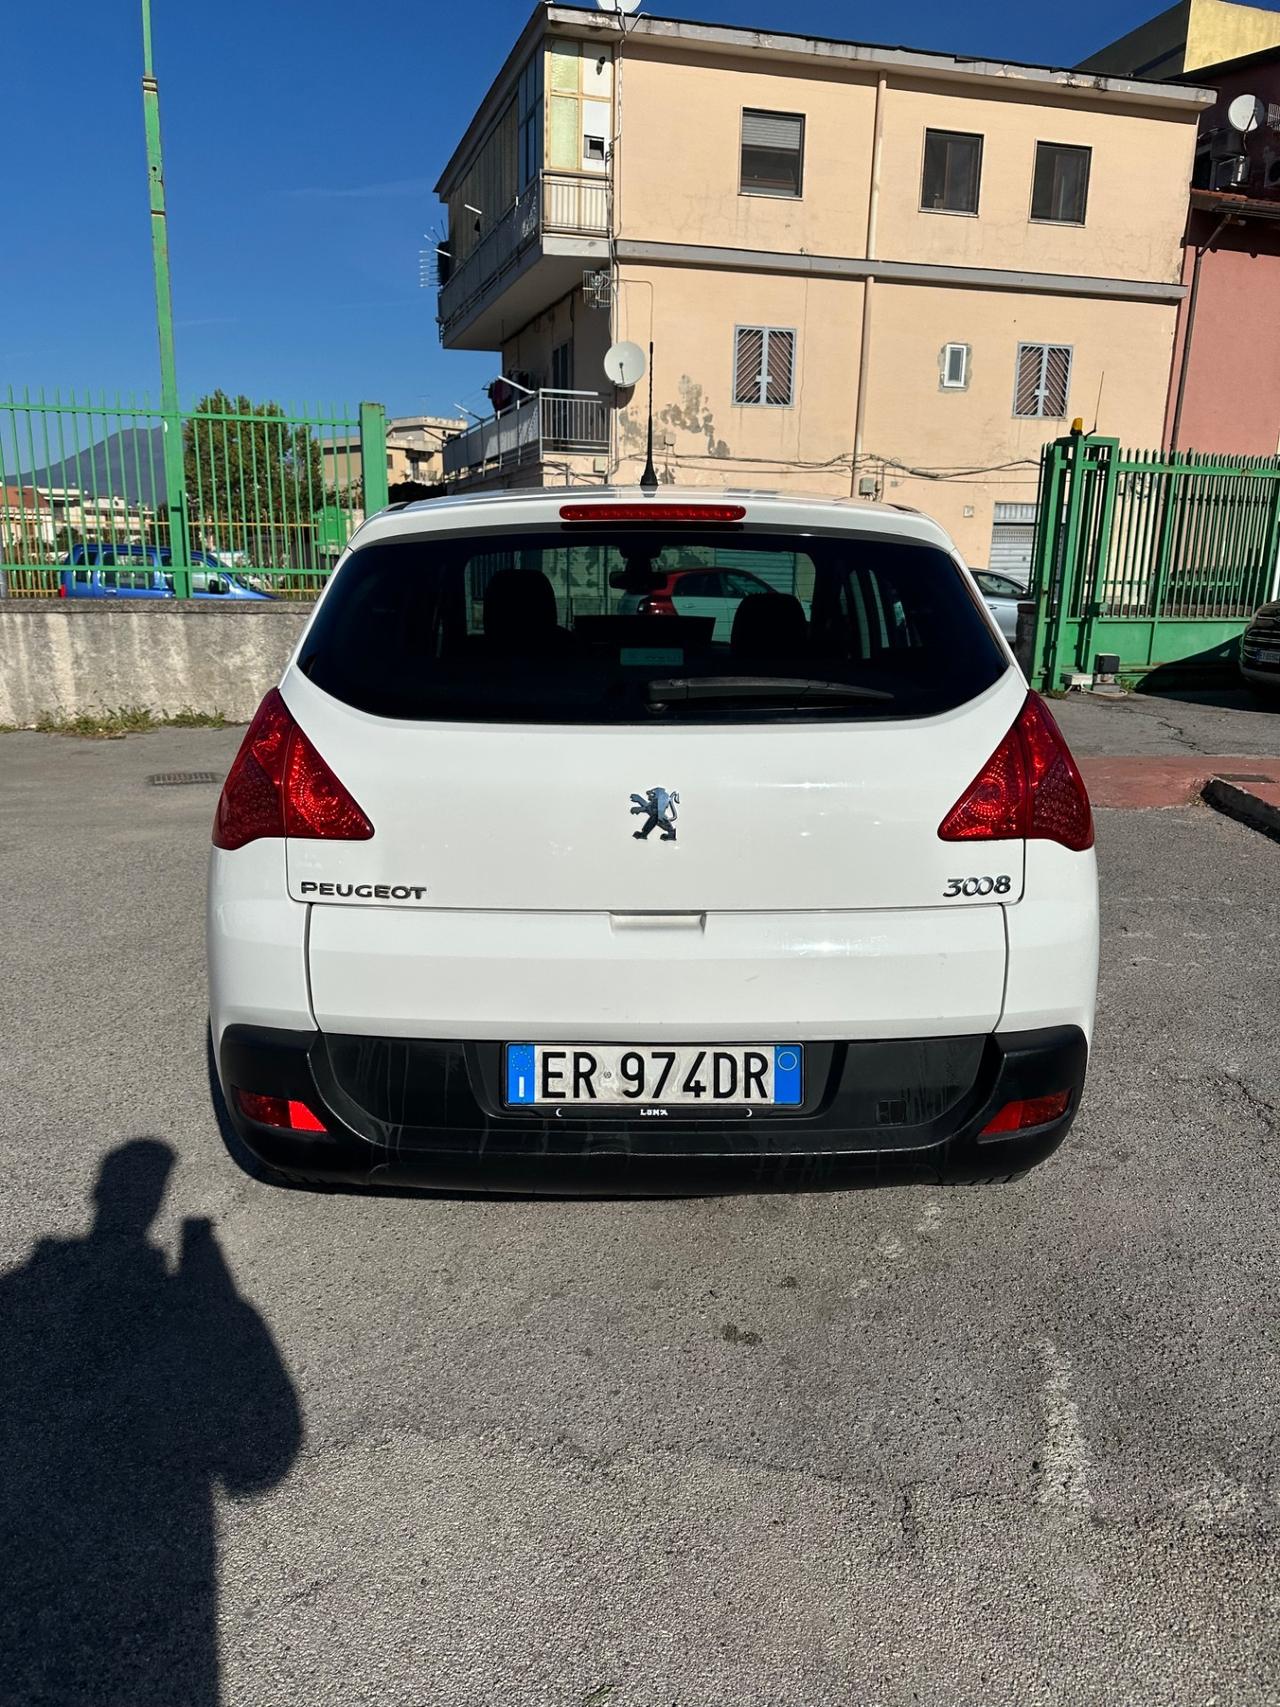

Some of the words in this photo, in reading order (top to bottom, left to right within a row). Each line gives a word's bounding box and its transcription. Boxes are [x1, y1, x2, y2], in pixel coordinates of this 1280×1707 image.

[301, 881, 427, 900] PEUGEOT
[943, 875, 1011, 897] 3008
[542, 1051, 597, 1099] ER
[620, 1051, 769, 1099] 974DR
